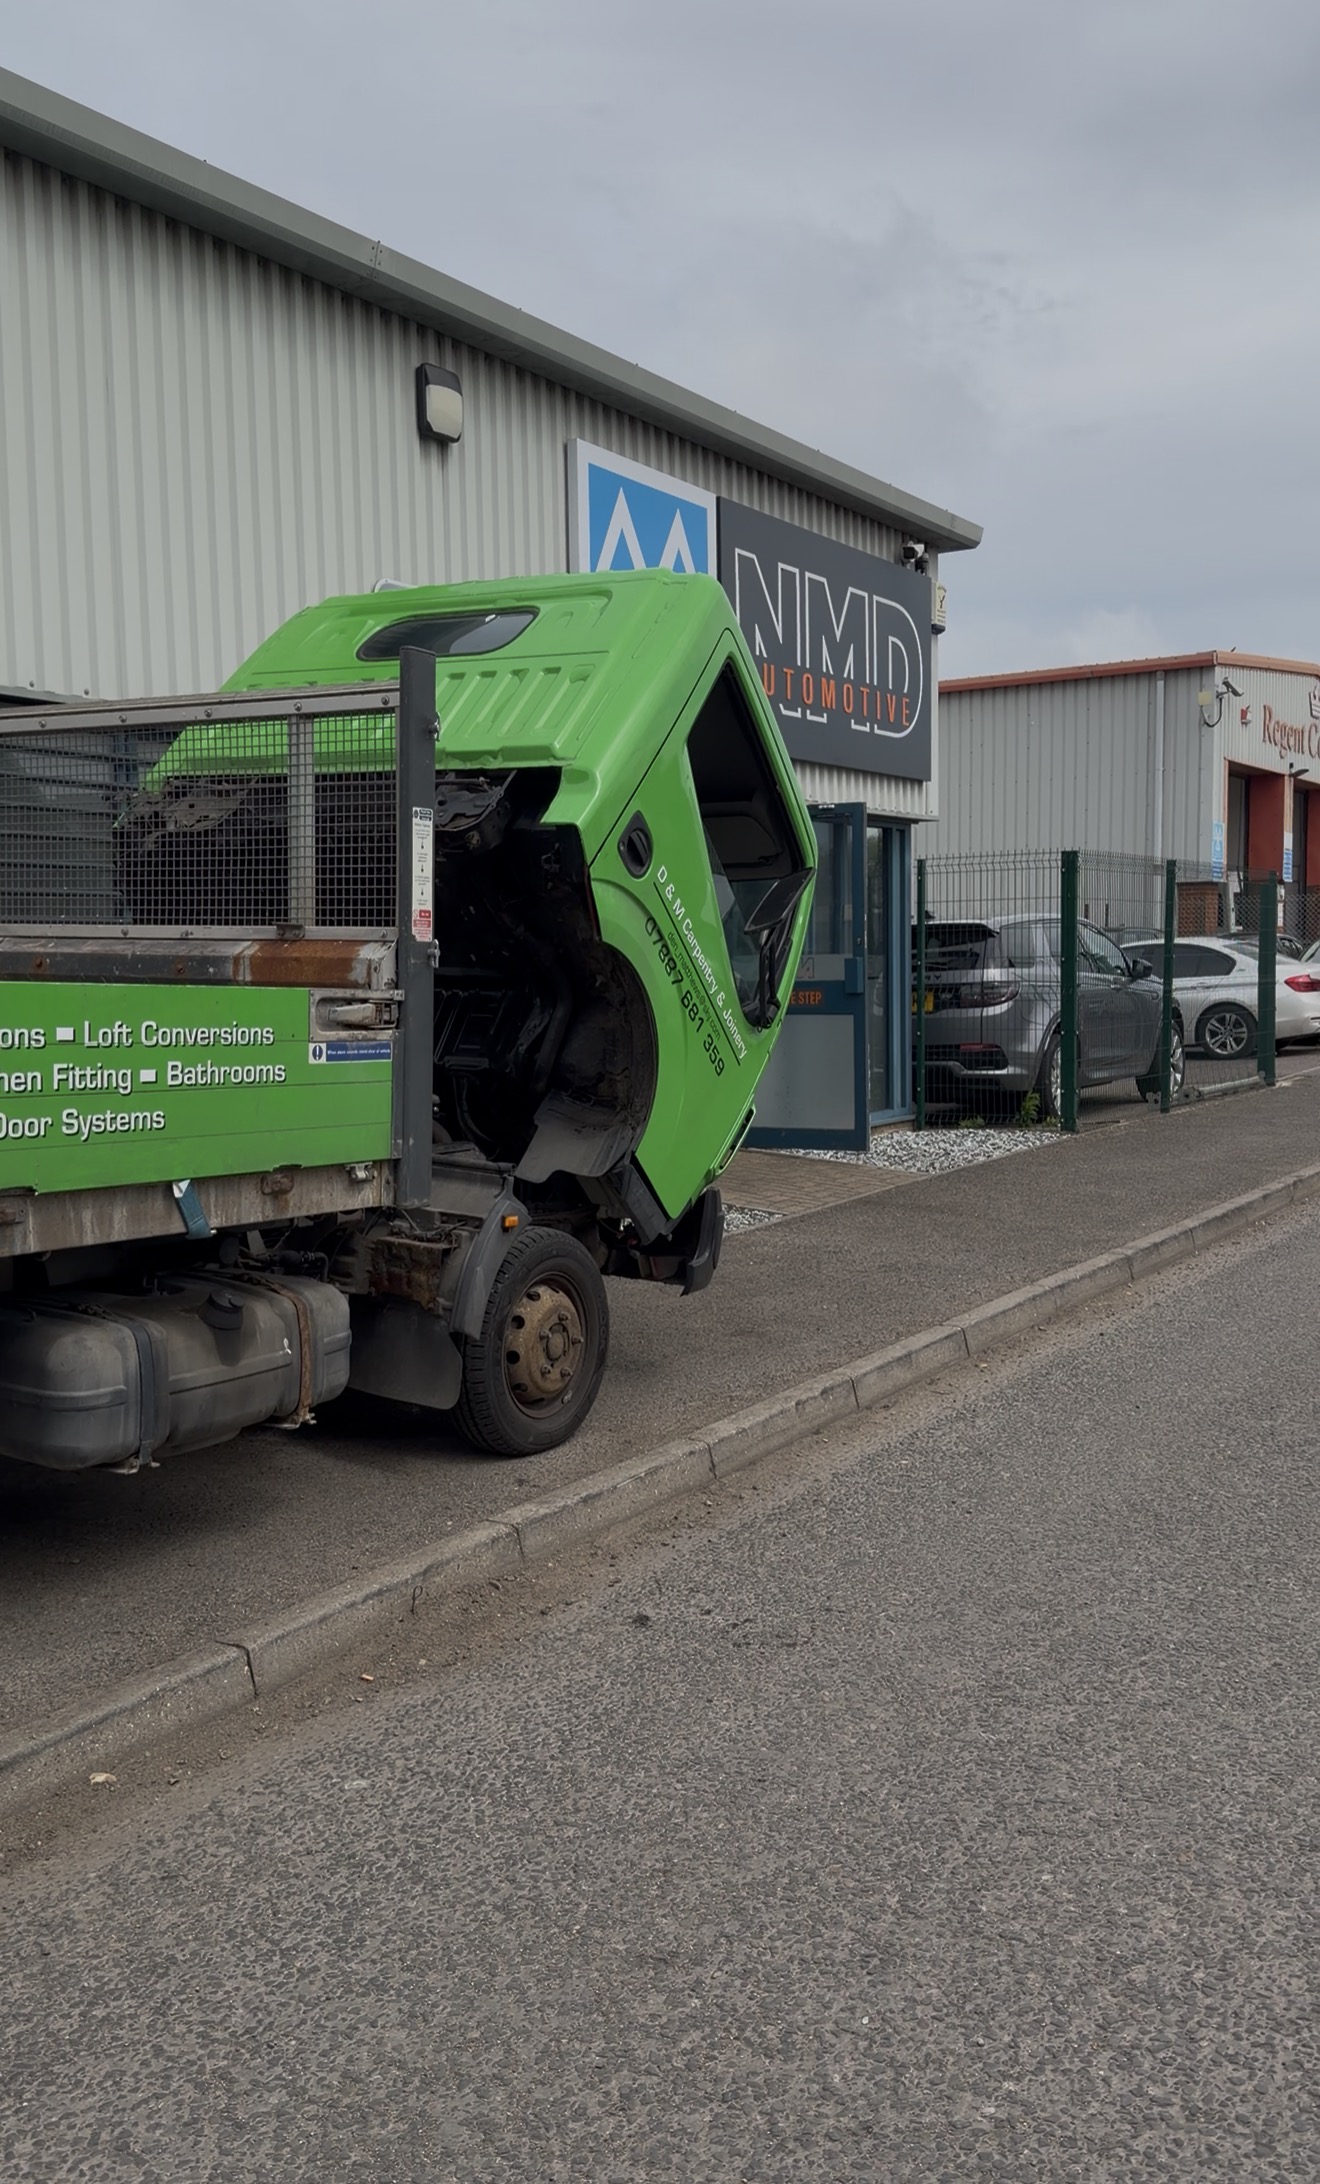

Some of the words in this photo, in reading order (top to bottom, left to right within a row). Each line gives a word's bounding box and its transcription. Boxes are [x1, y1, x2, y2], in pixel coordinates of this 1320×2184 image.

[735, 547, 923, 739] NMD
[762, 662, 910, 727] UTOMOTIVE
[1262, 704, 1304, 759] Regent
[657, 865, 668, 883] D
[665, 883, 675, 901] &
[672, 898, 686, 920] M
[682, 918, 719, 994] Carpentry
[716, 991, 726, 1009] &
[722, 1009, 748, 1060] Joinery
[644, 916, 684, 986] 07887
[681, 989, 704, 1033] 681
[702, 1033, 725, 1076] 359
[798, 991, 822, 1005] STEP
[84, 1020, 133, 1048] Loft
[140, 1020, 274, 1048] Conversions
[53, 1062, 132, 1095] Fitting
[166, 1059, 287, 1087] Bathrooms
[61, 1107, 166, 1142] Systems
